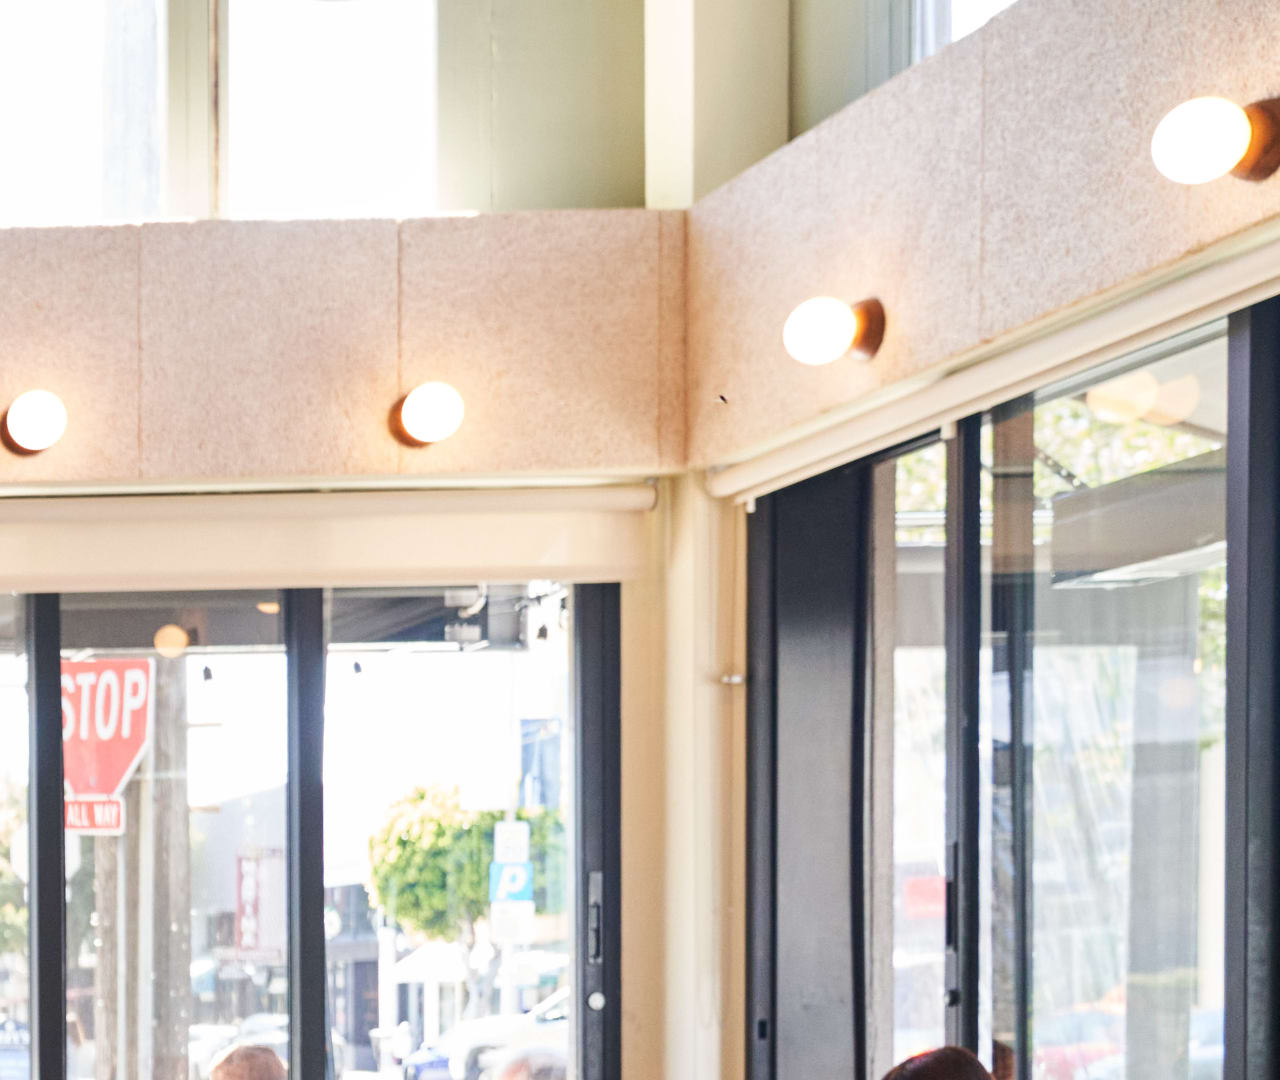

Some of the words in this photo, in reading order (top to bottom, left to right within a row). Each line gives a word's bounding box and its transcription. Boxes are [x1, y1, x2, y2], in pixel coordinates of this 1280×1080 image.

[61, 669, 147, 740] STOP
[67, 803, 89, 827] ALL
[94, 803, 118, 827] WAY
